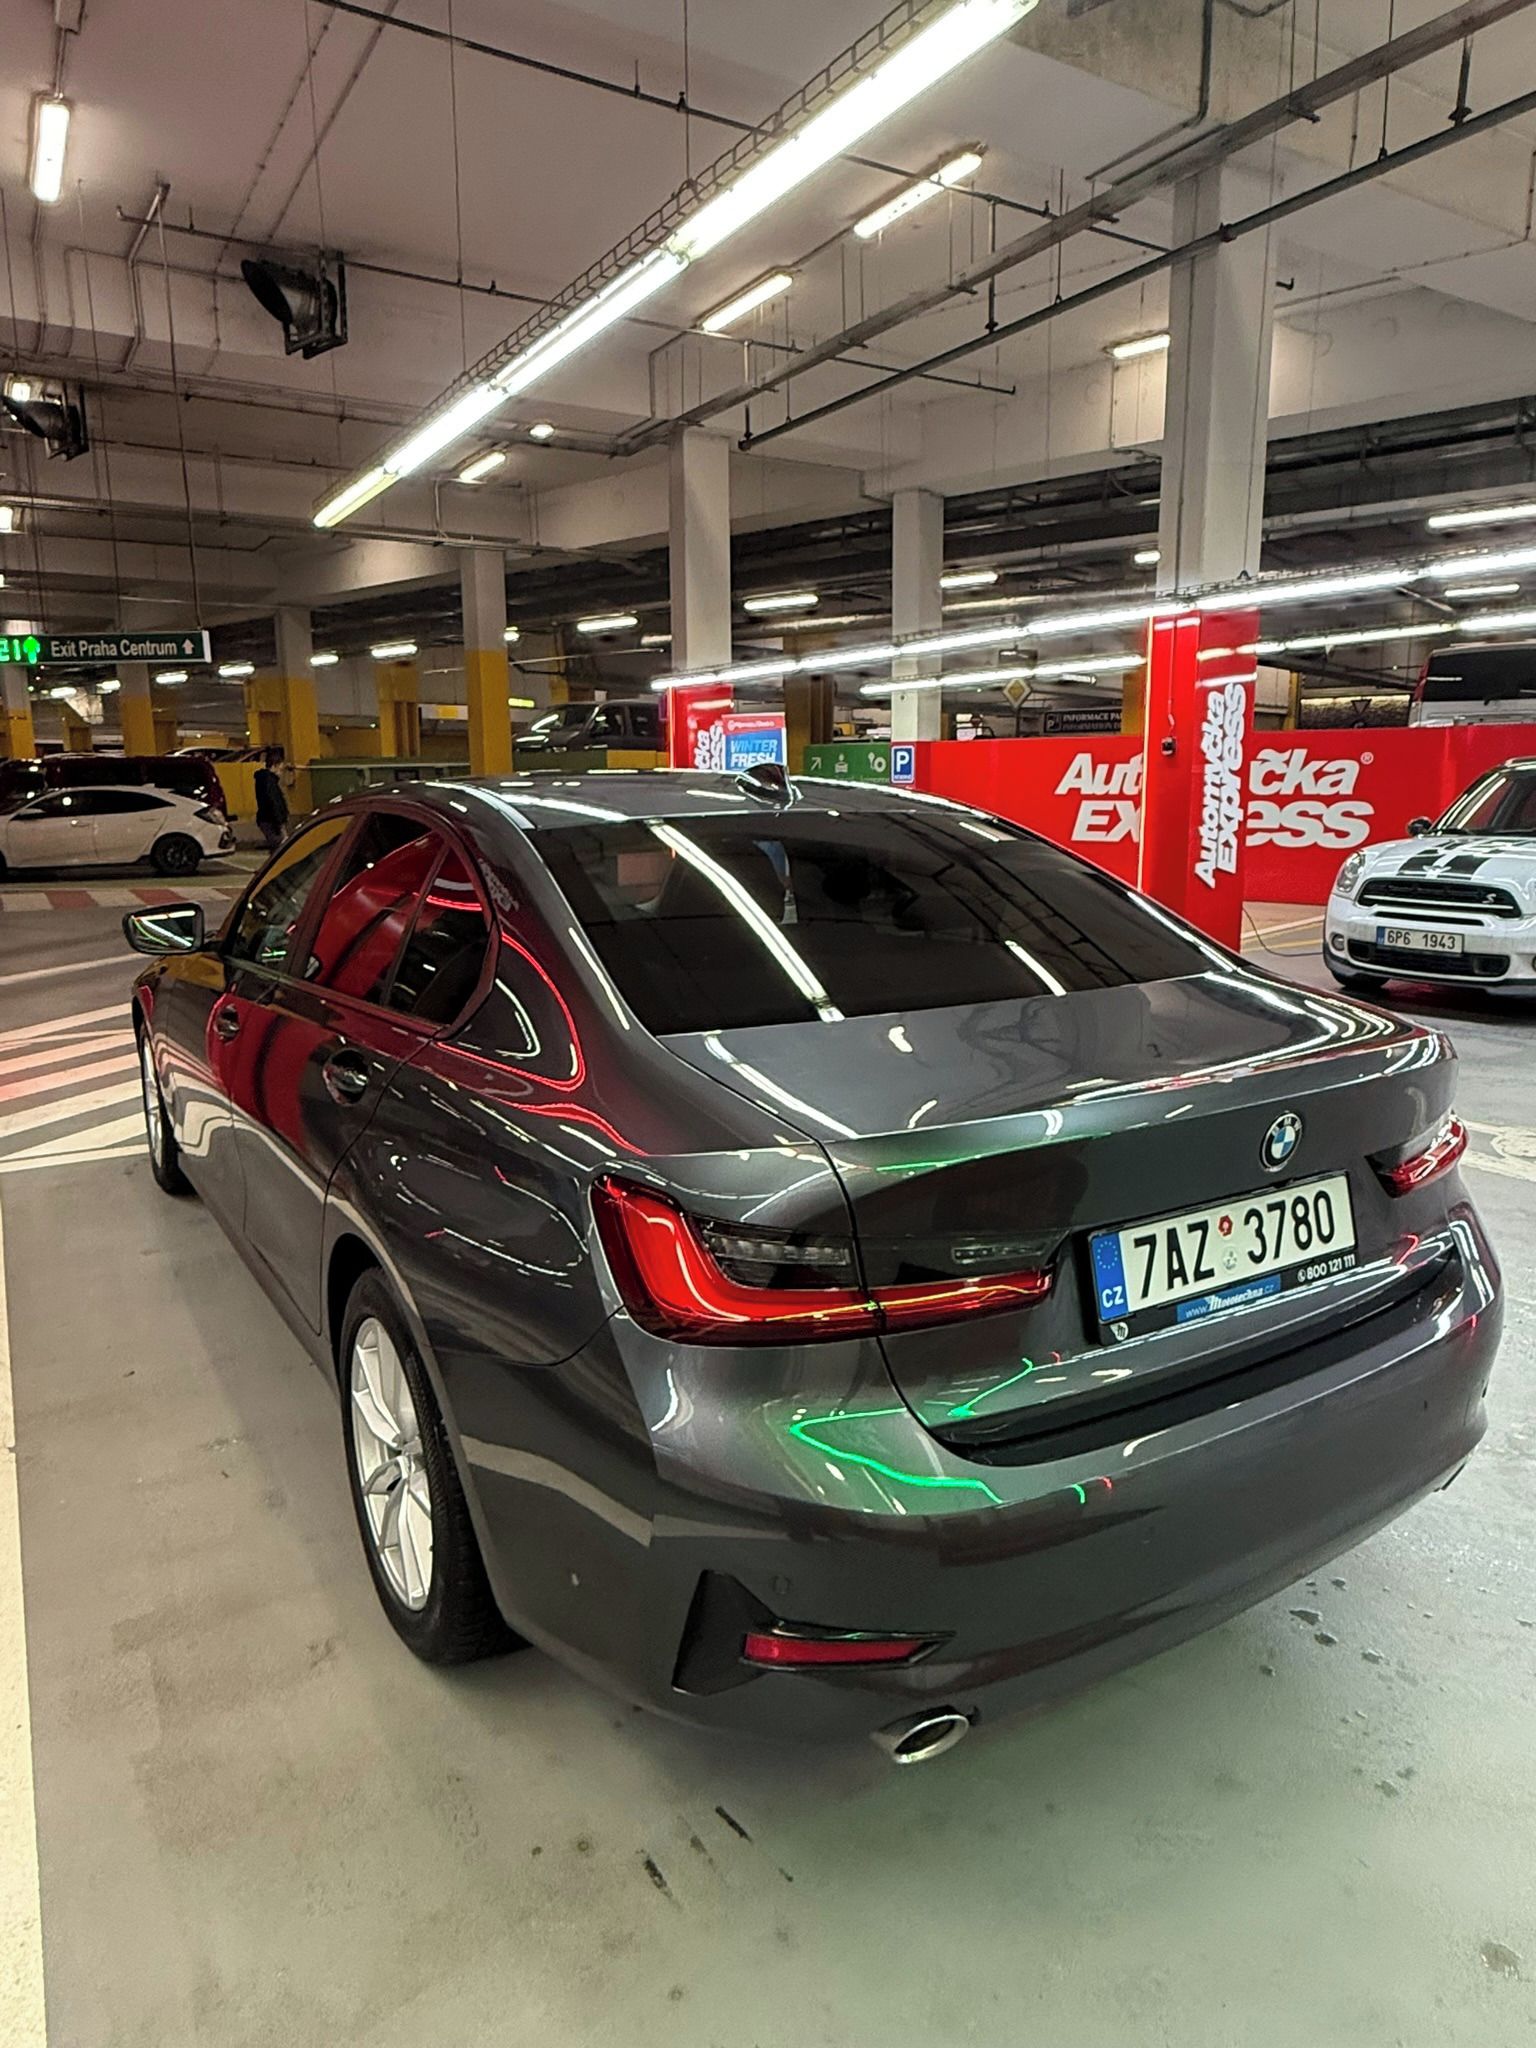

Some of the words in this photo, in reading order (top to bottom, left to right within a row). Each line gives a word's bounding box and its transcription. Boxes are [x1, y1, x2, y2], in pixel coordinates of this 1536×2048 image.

[51, 640, 77, 657] Exit
[79, 639, 117, 656] Praha
[119, 638, 178, 656] Centrum
[1062, 712, 1110, 722] INFORMACE
[731, 739, 778, 753] WINTER
[731, 752, 776, 769] FRESH
[896, 750, 910, 773] P
[1387, 929, 1411, 946] 6P6
[1422, 932, 1456, 950] 1943
[1133, 1219, 1216, 1300] 7AZ
[1243, 1189, 1336, 1265] 3780
[1307, 1262, 1328, 1280] 800
[1328, 1257, 1343, 1274] 121
[1343, 1253, 1356, 1269] 111
[1101, 1285, 1124, 1309] CZ
